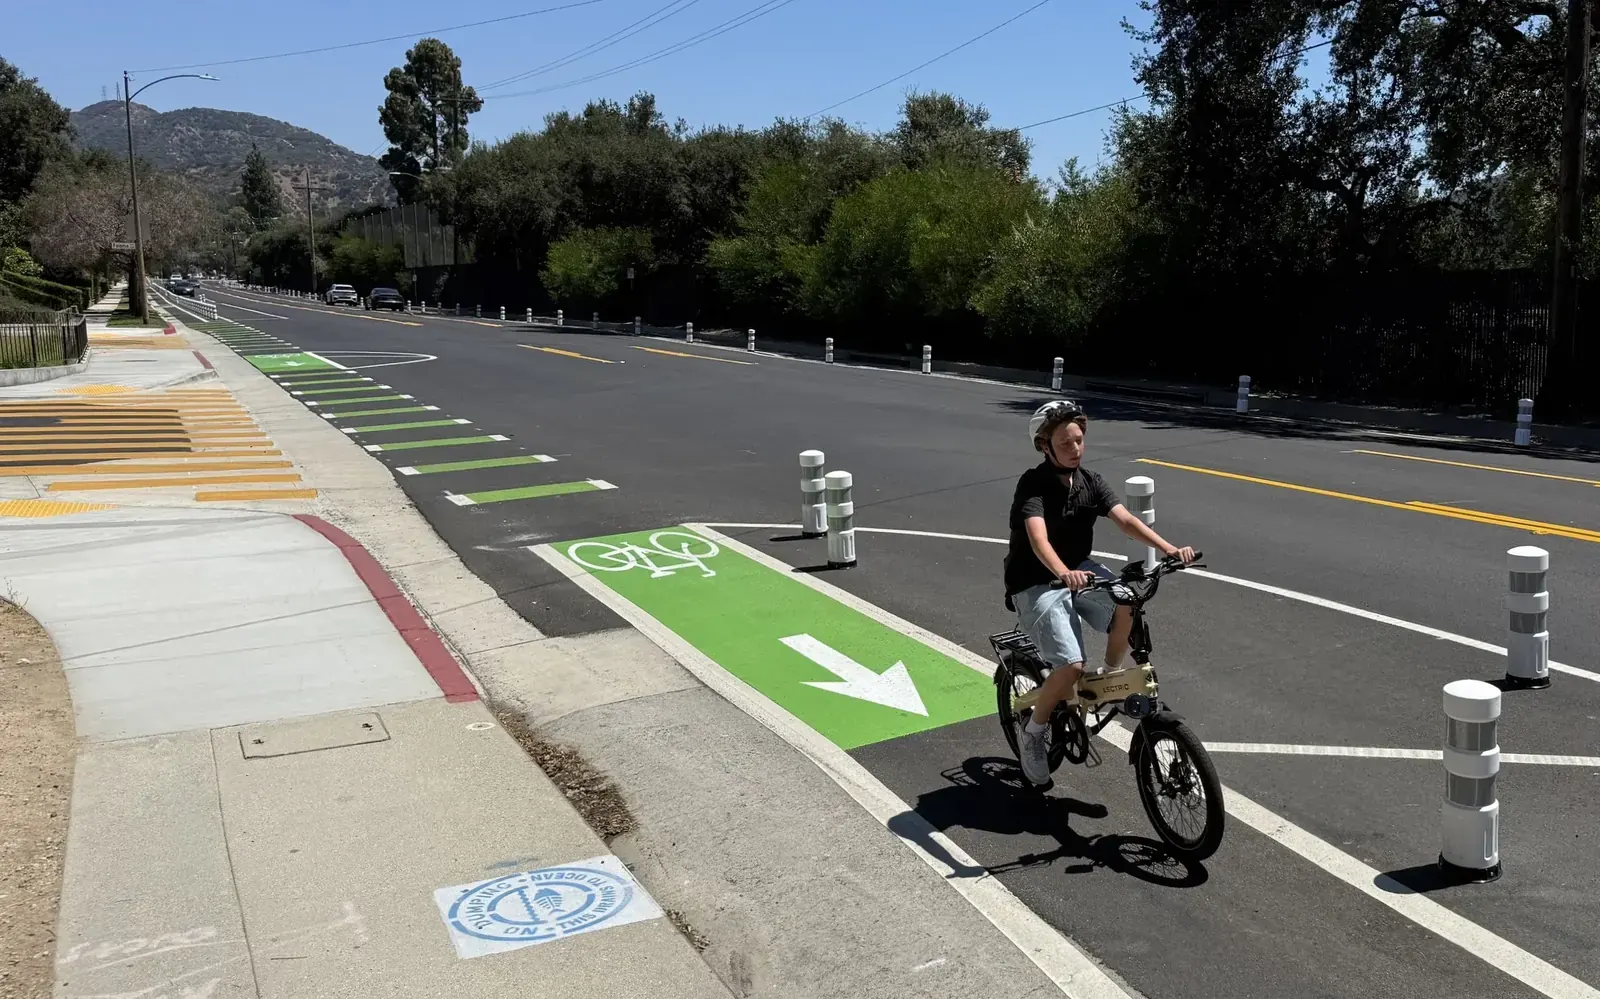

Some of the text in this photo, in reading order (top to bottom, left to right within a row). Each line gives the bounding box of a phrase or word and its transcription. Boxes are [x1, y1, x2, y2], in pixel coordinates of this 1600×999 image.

[465, 872, 617, 936] NO DUMPING THIS DRAINS TO OCEAN
